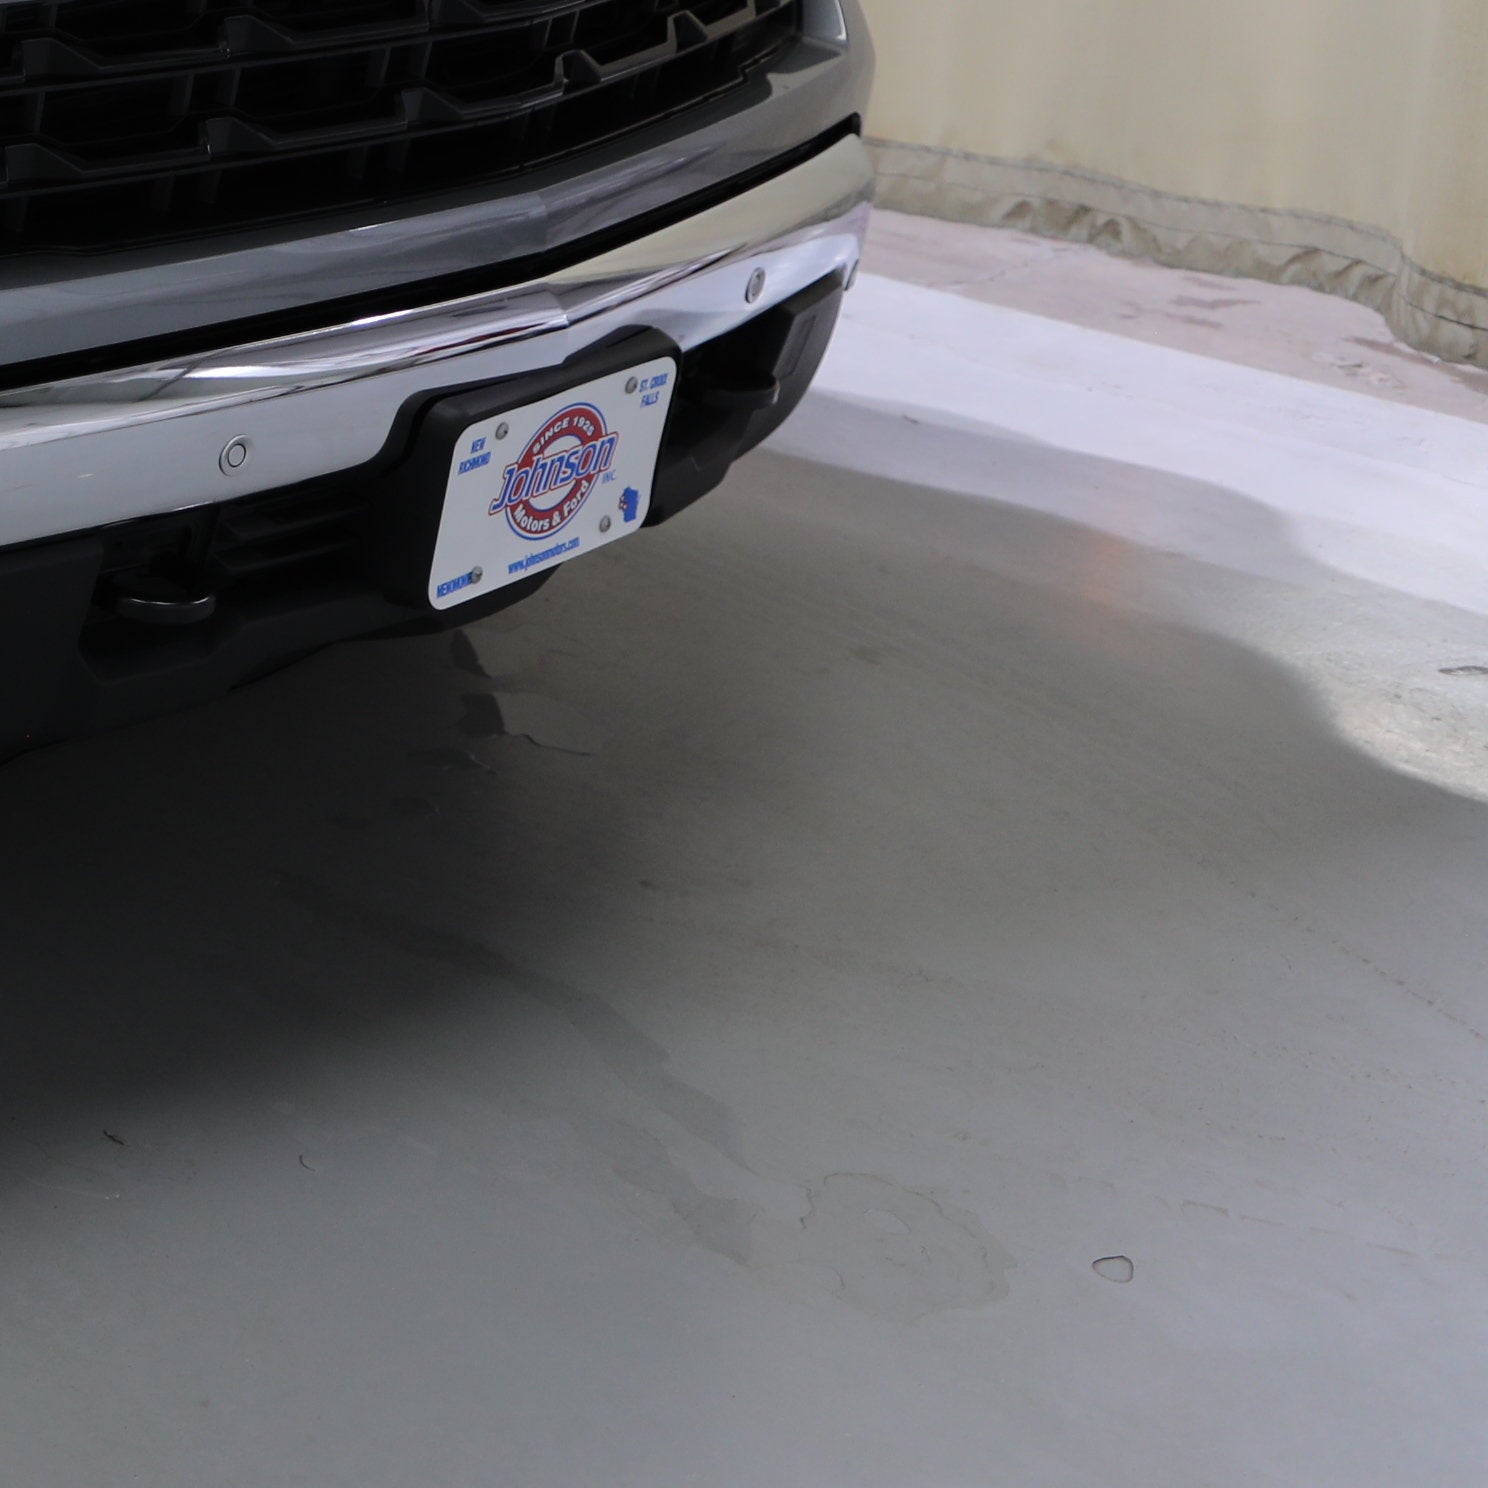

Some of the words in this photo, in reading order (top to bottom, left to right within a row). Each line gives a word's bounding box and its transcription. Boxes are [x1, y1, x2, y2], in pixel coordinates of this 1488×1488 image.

[640, 390, 660, 408] FALLS
[470, 436, 487, 454] NEW
[533, 417, 571, 454] SINCE
[490, 433, 617, 514] Johnson
[513, 503, 550, 532] Motors
[552, 511, 562, 526] &
[563, 479, 590, 517] Ford
